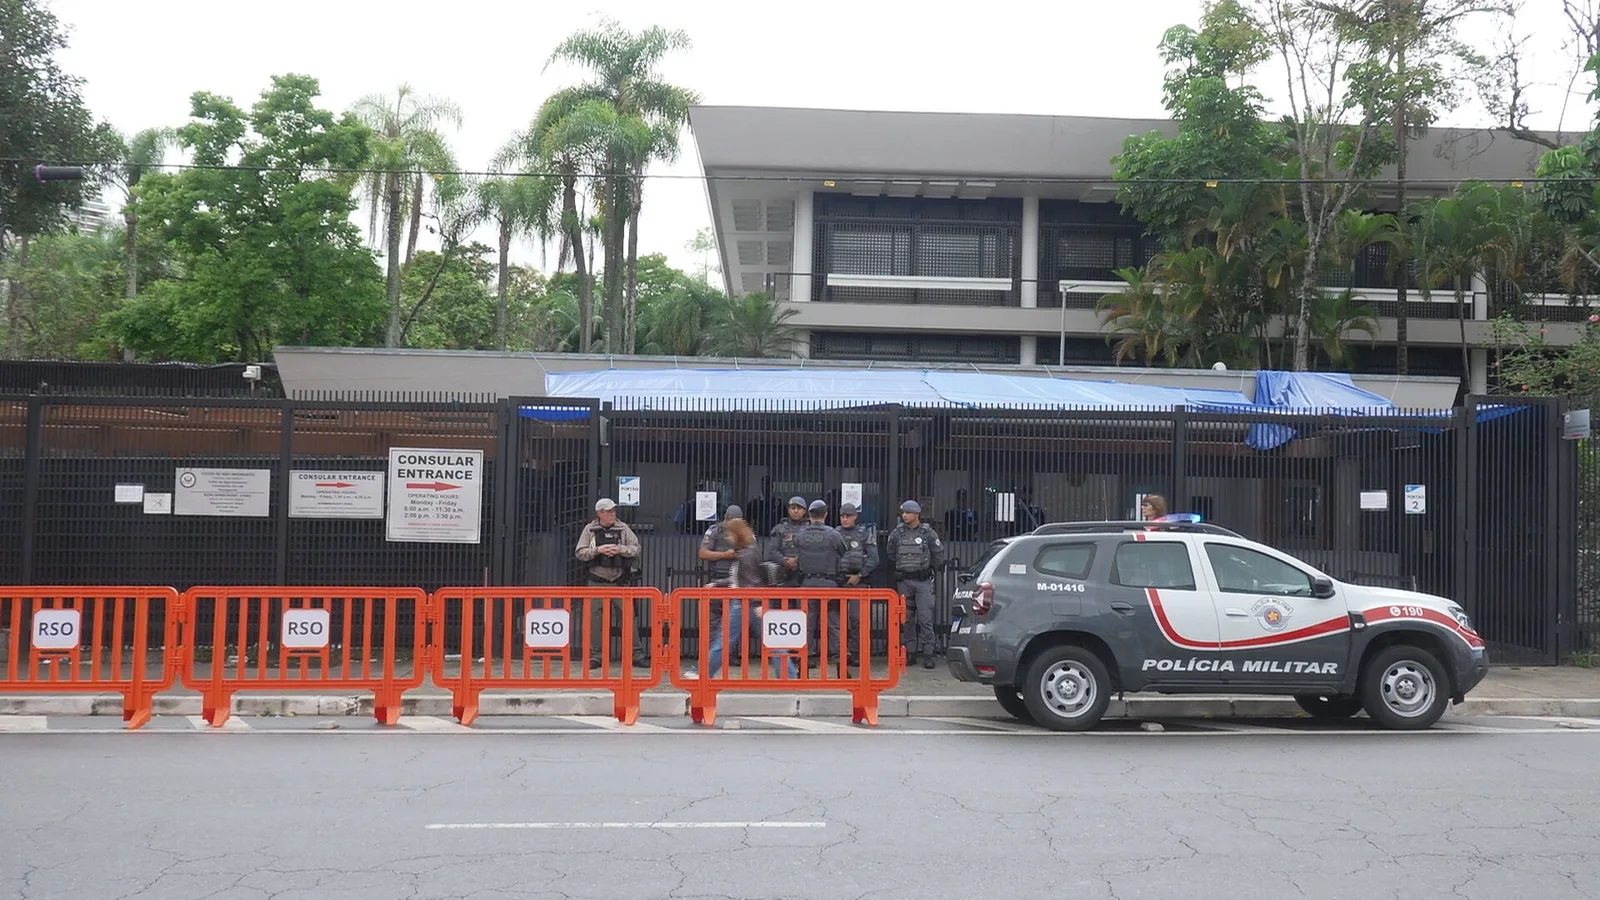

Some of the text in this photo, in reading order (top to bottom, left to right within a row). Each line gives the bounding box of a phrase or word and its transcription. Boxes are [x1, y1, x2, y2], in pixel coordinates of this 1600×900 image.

[398, 454, 474, 466] CONSULAR
[397, 468, 473, 480] ENTRANCE
[627, 493, 632, 502] 1
[1412, 500, 1418, 510] 2
[1036, 582, 1085, 592] M-01416
[1402, 606, 1424, 616] 190
[38, 621, 74, 636] RSO
[287, 620, 323, 636] RSO
[530, 621, 564, 635] RSO
[768, 622, 802, 636] RSO
[1142, 657, 1338, 674] POLÍCIA MILITAR
